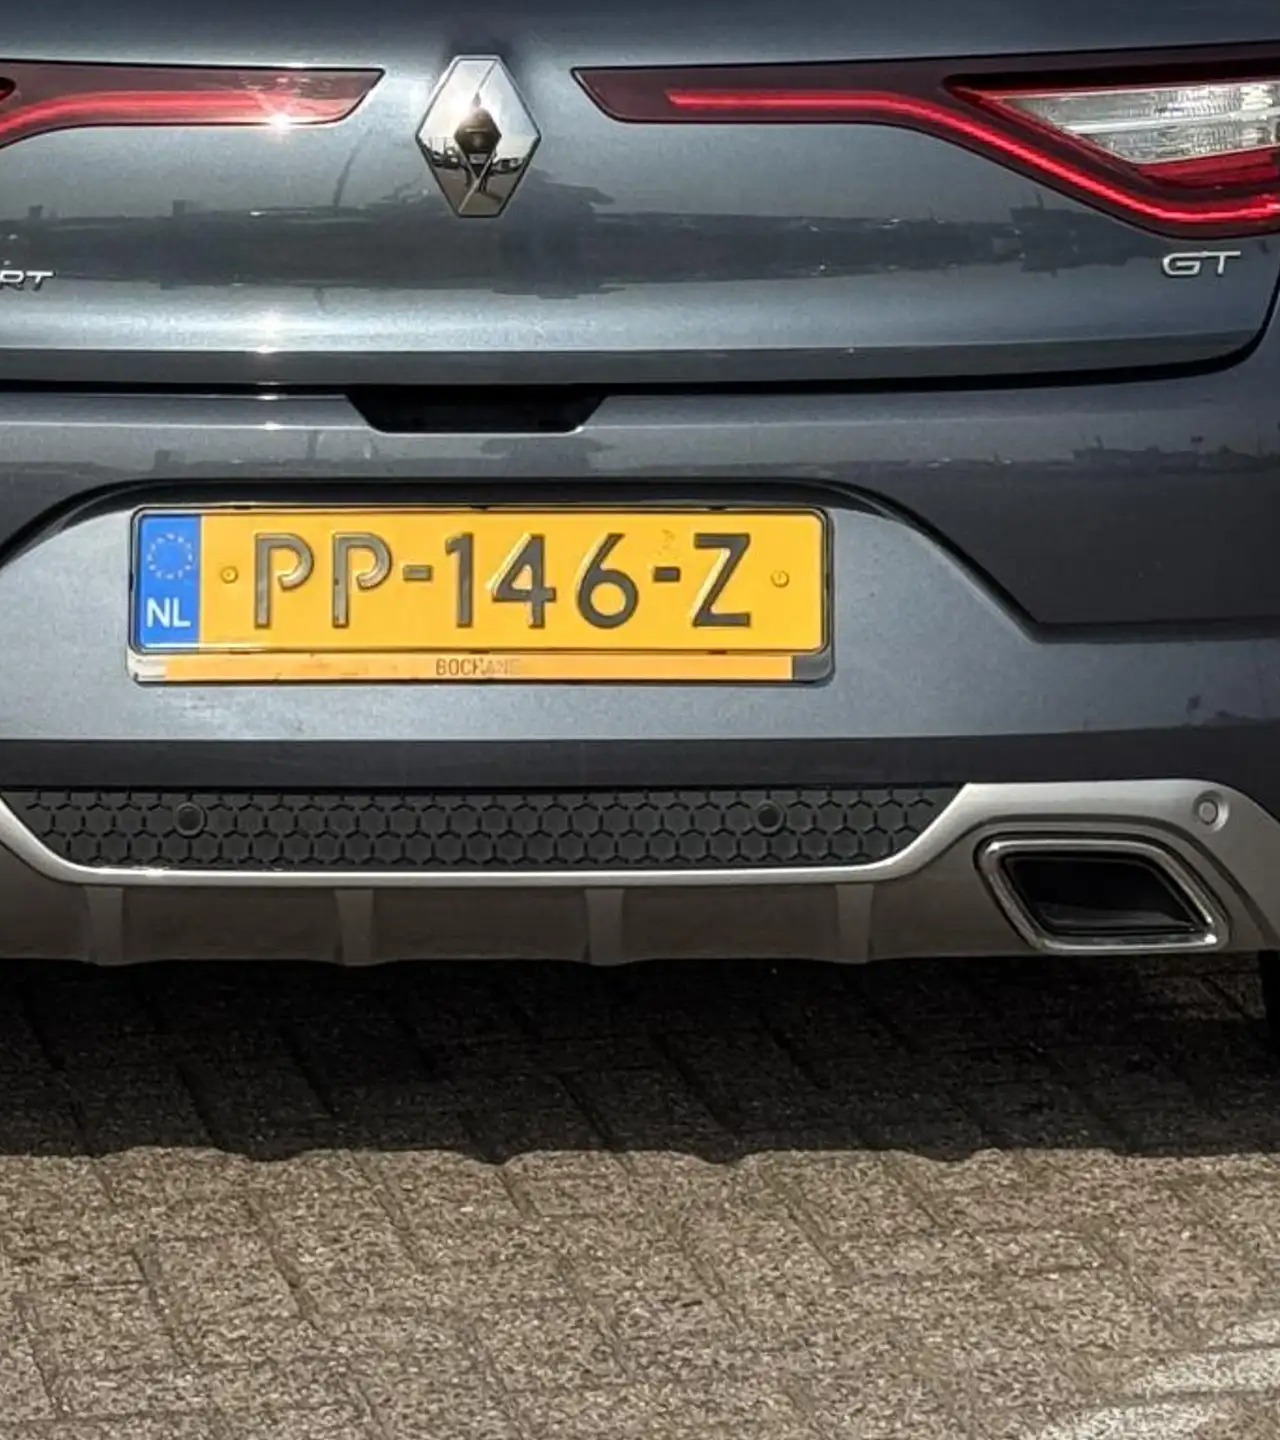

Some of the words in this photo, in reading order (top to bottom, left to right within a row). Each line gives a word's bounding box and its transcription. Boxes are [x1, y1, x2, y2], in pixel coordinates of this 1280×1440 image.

[1163, 251, 1241, 275] GT
[253, 531, 753, 629] PP-146-Z
[146, 597, 191, 628] NL
